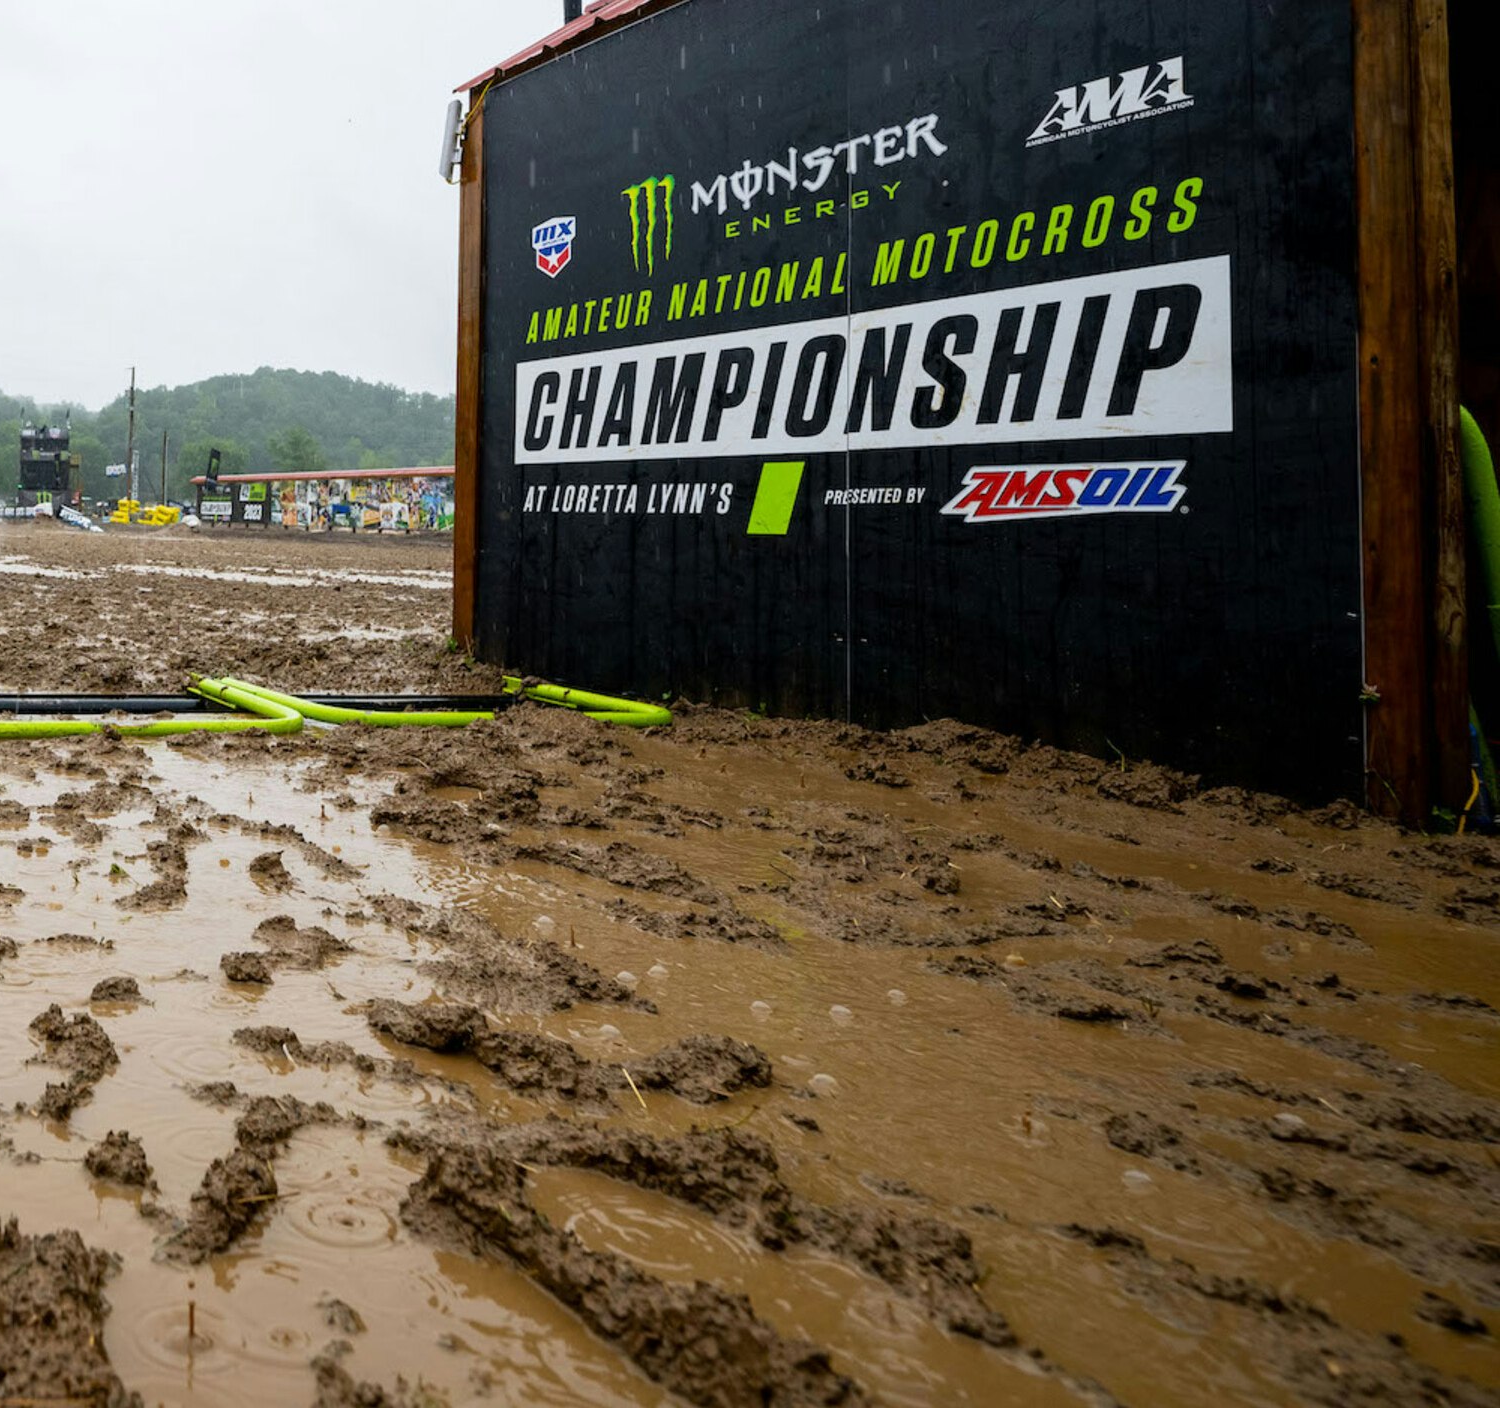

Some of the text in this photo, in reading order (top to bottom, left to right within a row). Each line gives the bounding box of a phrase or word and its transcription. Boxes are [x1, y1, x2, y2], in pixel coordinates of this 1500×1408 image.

[1025, 55, 1194, 140] AMA
[1025, 99, 1195, 148] AMERICAN MOTORCYCLIST ASSOCIATION
[690, 113, 948, 215] MONSTER
[725, 181, 902, 238] ENERGY
[525, 177, 1204, 344] AMATEUR NATIONAL MOTOCROSS
[523, 283, 1202, 452] CHAMPIONSHIP
[523, 482, 733, 514] AT LORETTA LYNN'S
[824, 487, 926, 505] PRESENTED BY
[951, 466, 1180, 517] AMSOIL
